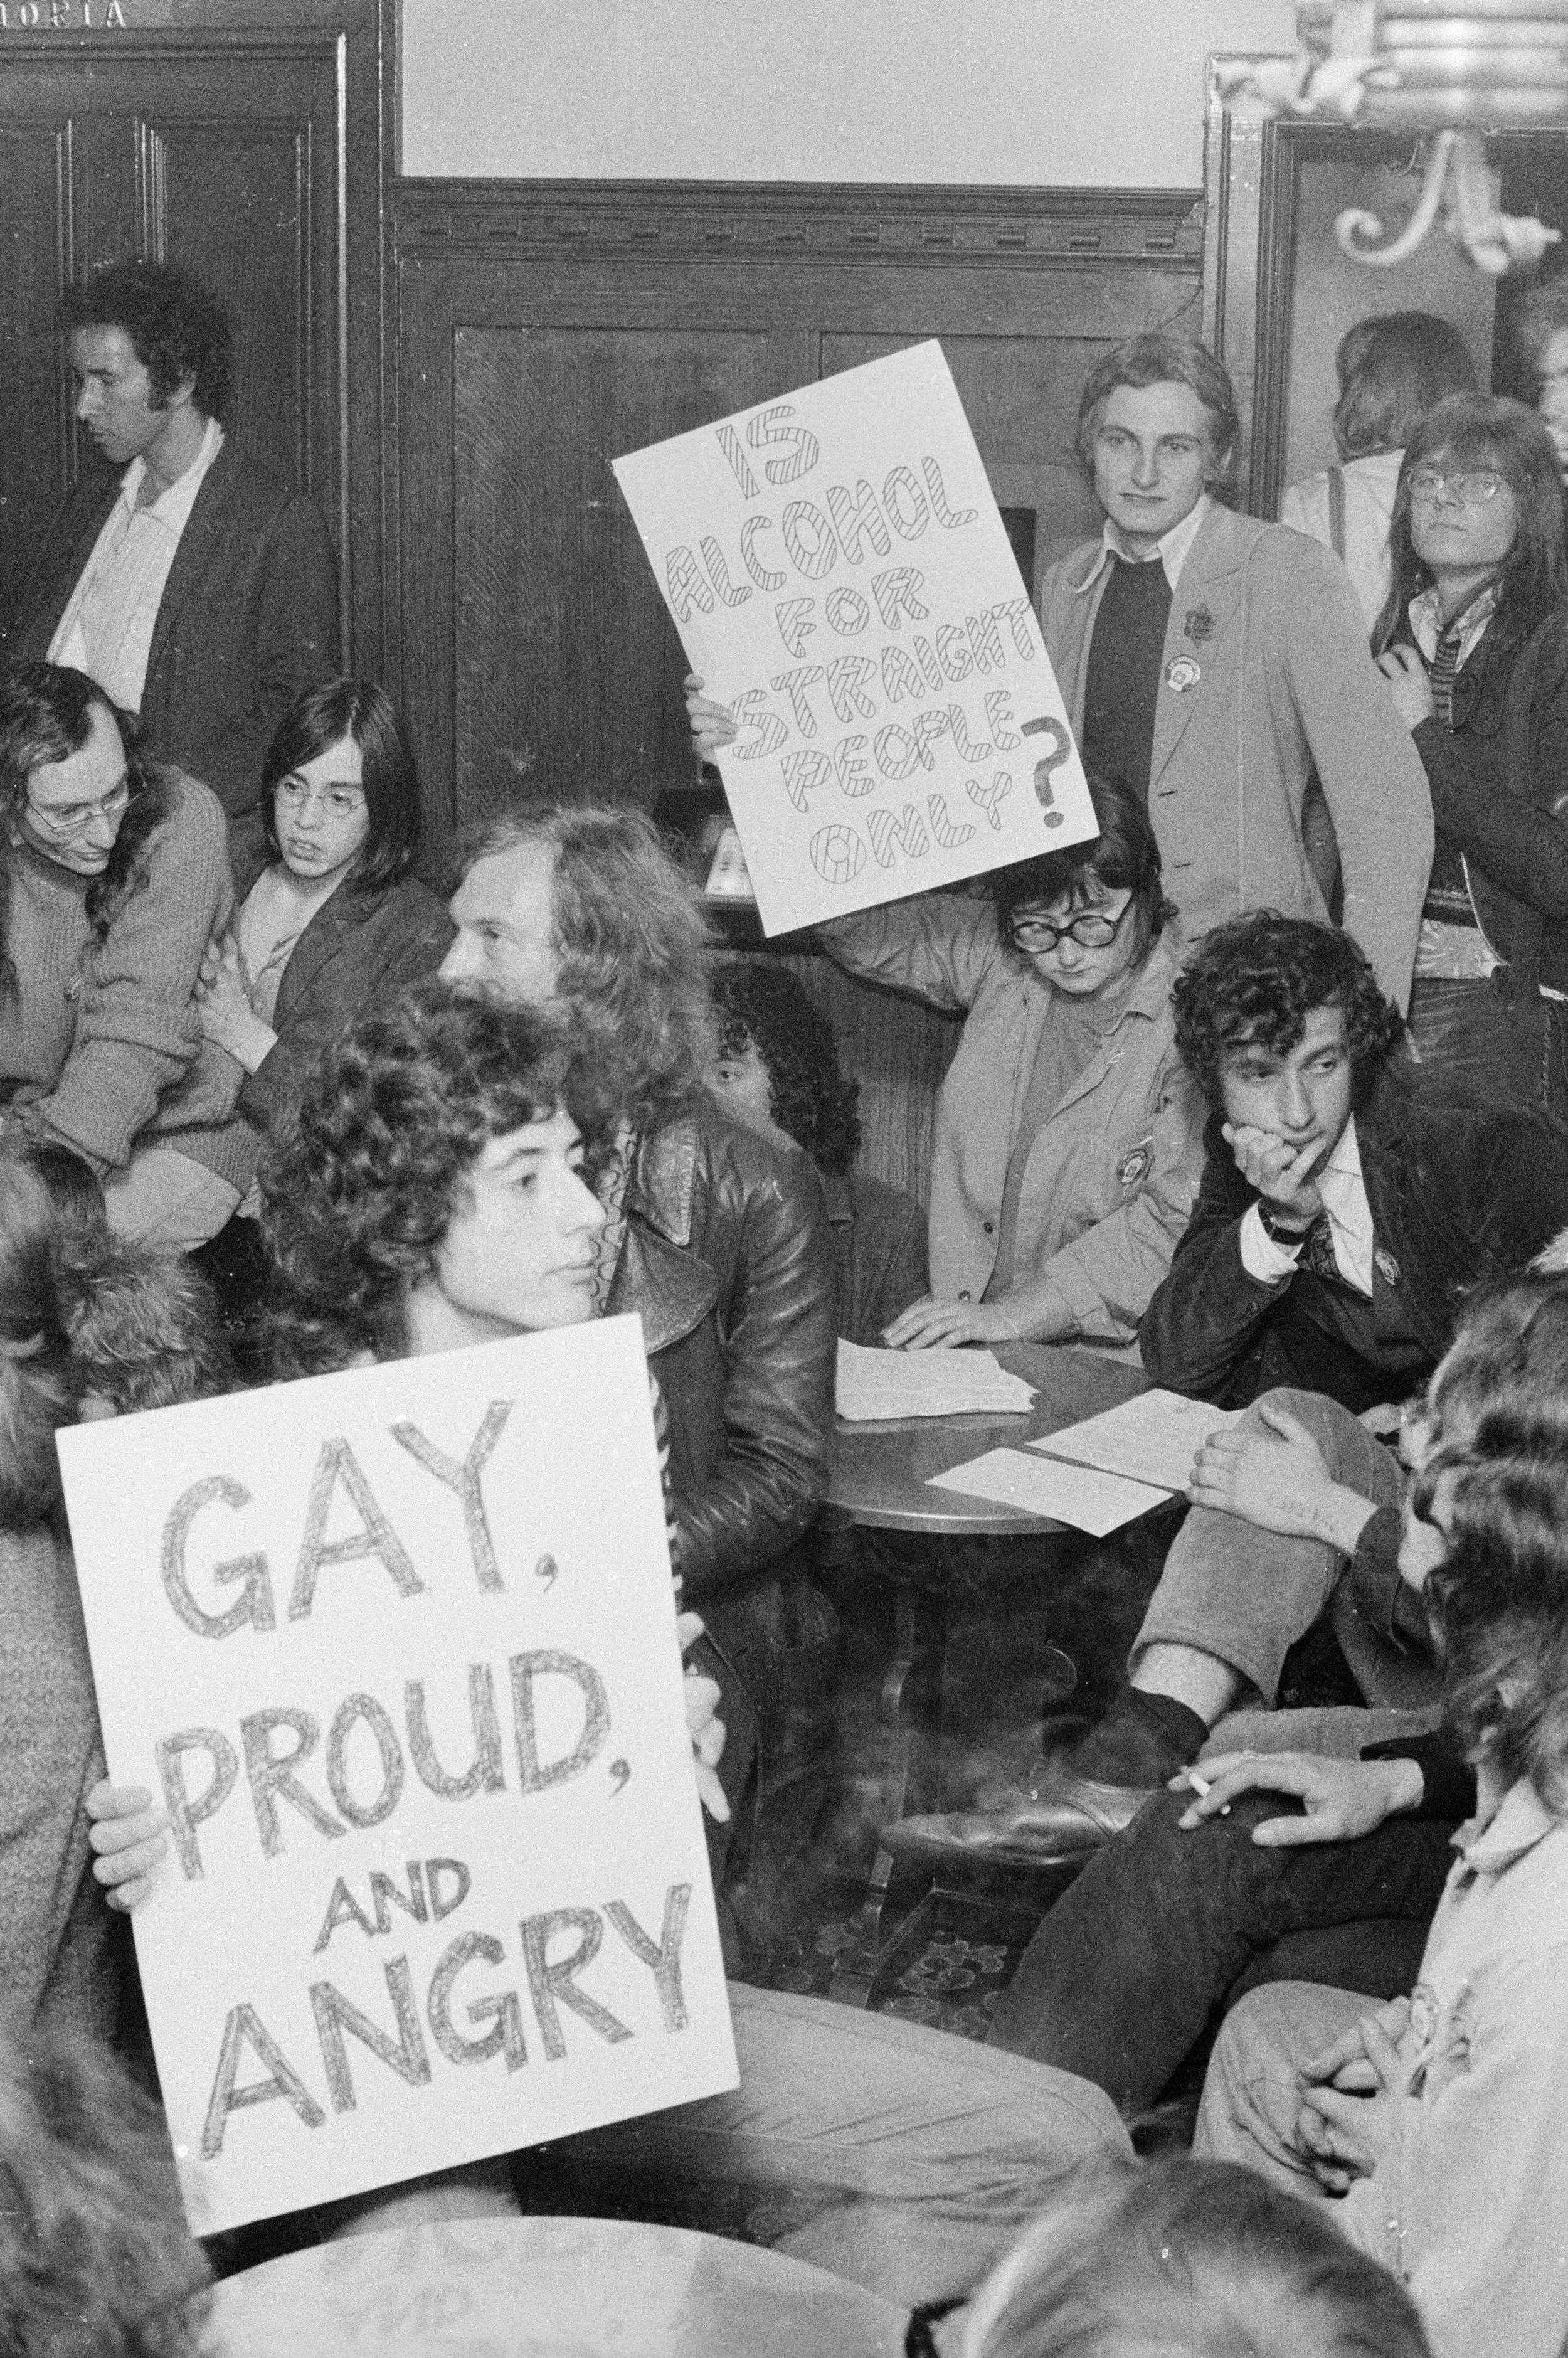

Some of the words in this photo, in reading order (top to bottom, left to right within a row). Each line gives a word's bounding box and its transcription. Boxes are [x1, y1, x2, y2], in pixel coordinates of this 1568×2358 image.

[716, 405, 819, 499] IS
[666, 456, 978, 622] ALCOHOL
[775, 567, 929, 657] FOR
[728, 597, 1034, 760] STRAIGHT
[781, 691, 1021, 813] PEOPLE
[160, 1399, 557, 1639] GAY,
[154, 1649, 630, 1881] PROUD,
[313, 1858, 472, 1955] AND
[199, 1884, 693, 2162] ANGRY
